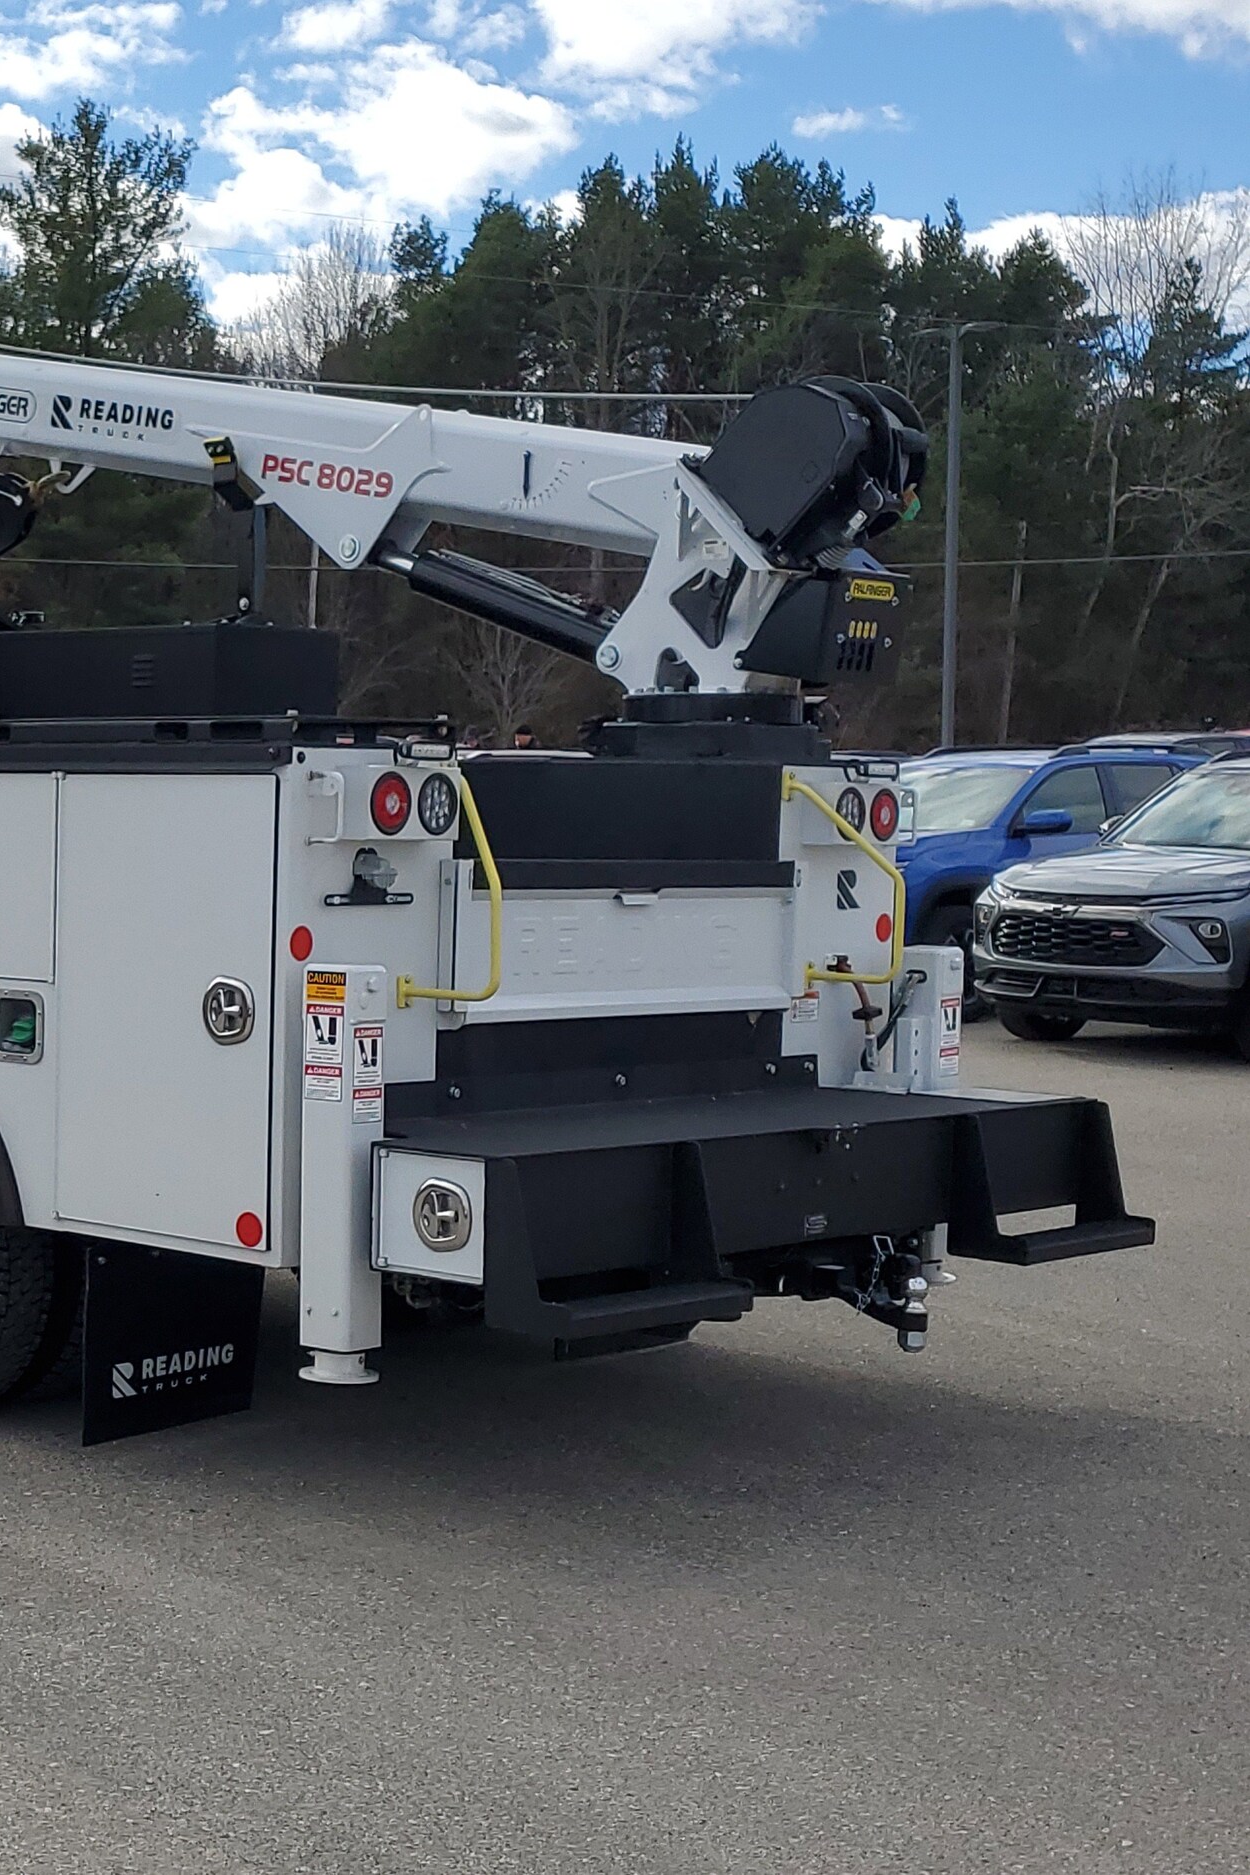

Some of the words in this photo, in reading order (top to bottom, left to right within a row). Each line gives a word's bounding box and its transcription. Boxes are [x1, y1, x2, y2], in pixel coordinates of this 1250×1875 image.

[79, 398, 175, 430] READING
[78, 424, 145, 442] TRUCK
[261, 453, 314, 487] PSC
[316, 463, 394, 499] 8029
[307, 972, 345, 985] CAUTION
[314, 1006, 343, 1015] DANGER
[313, 1067, 340, 1076] DANGER
[142, 1343, 235, 1380] READING
[141, 1373, 208, 1394] TRUCK
